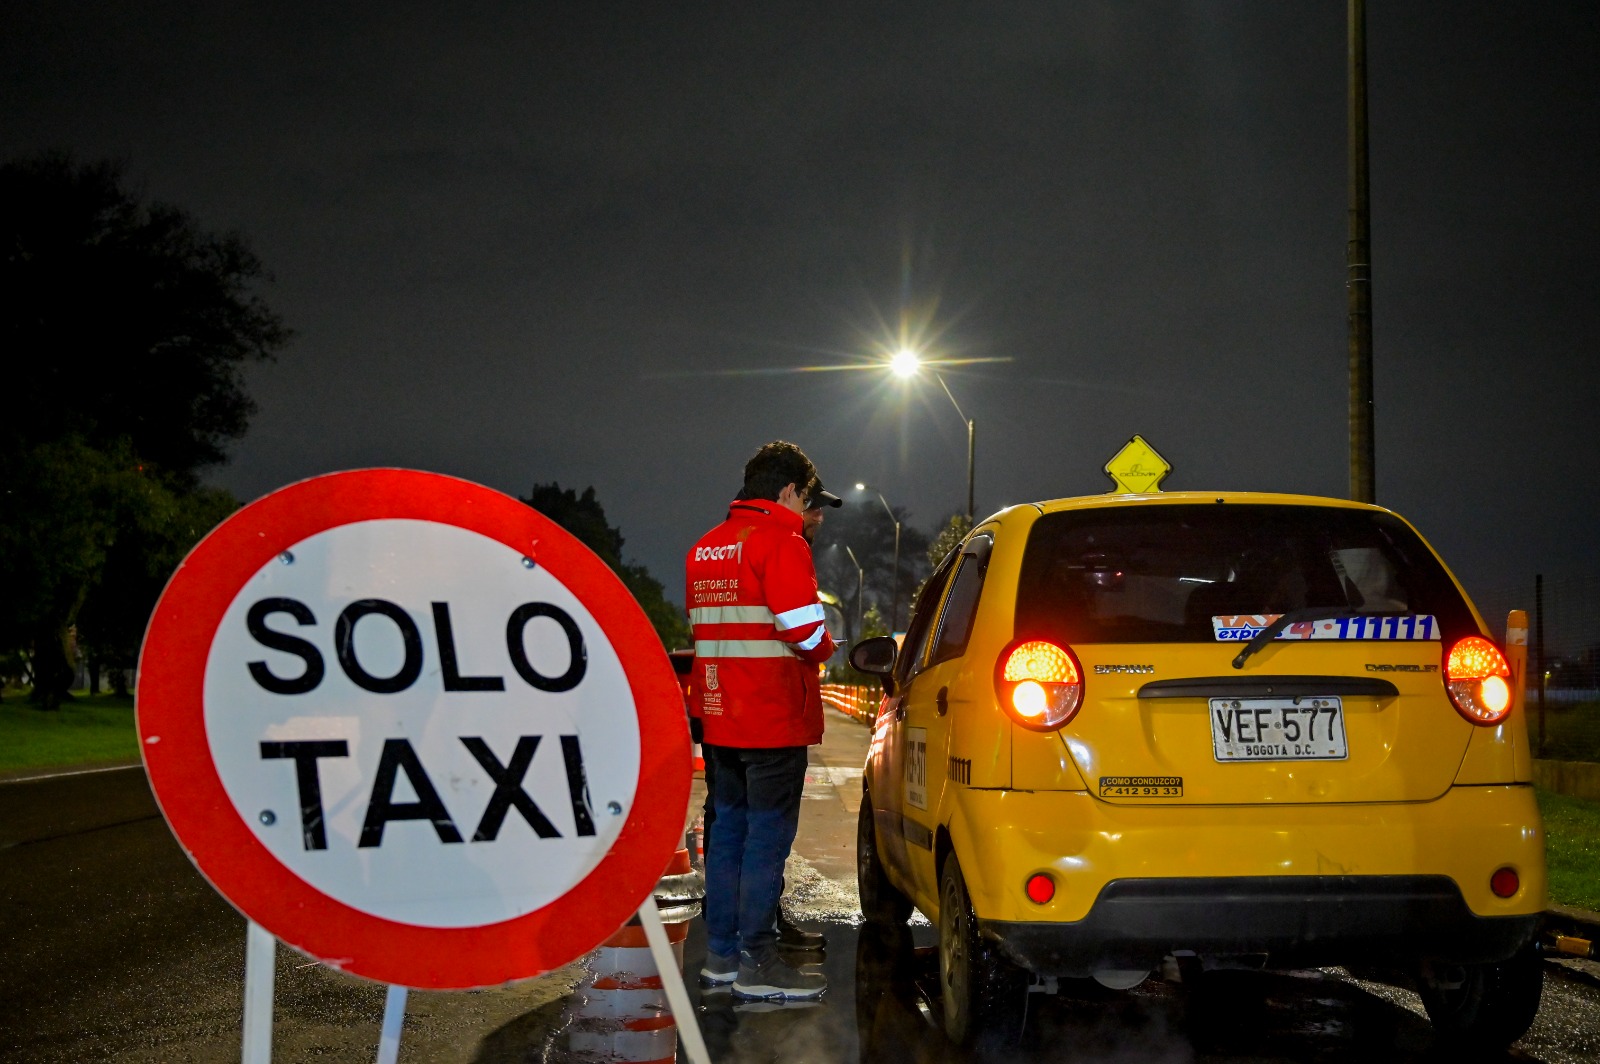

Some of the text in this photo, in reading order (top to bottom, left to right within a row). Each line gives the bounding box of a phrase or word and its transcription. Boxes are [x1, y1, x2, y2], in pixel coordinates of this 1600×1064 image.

[693, 579, 739, 591] GESTORES DE
[694, 592, 738, 603] CONVIVENCIA
[246, 597, 588, 696] SOLO
[1365, 664, 1439, 673] CHEVROLET
[1246, 744, 1316, 756] BOGOTA D.C.
[1101, 777, 1180, 786] ¿COMO CONDUZCO?
[259, 734, 597, 851] TAXI
[1115, 787, 1178, 795] 412 93 33
